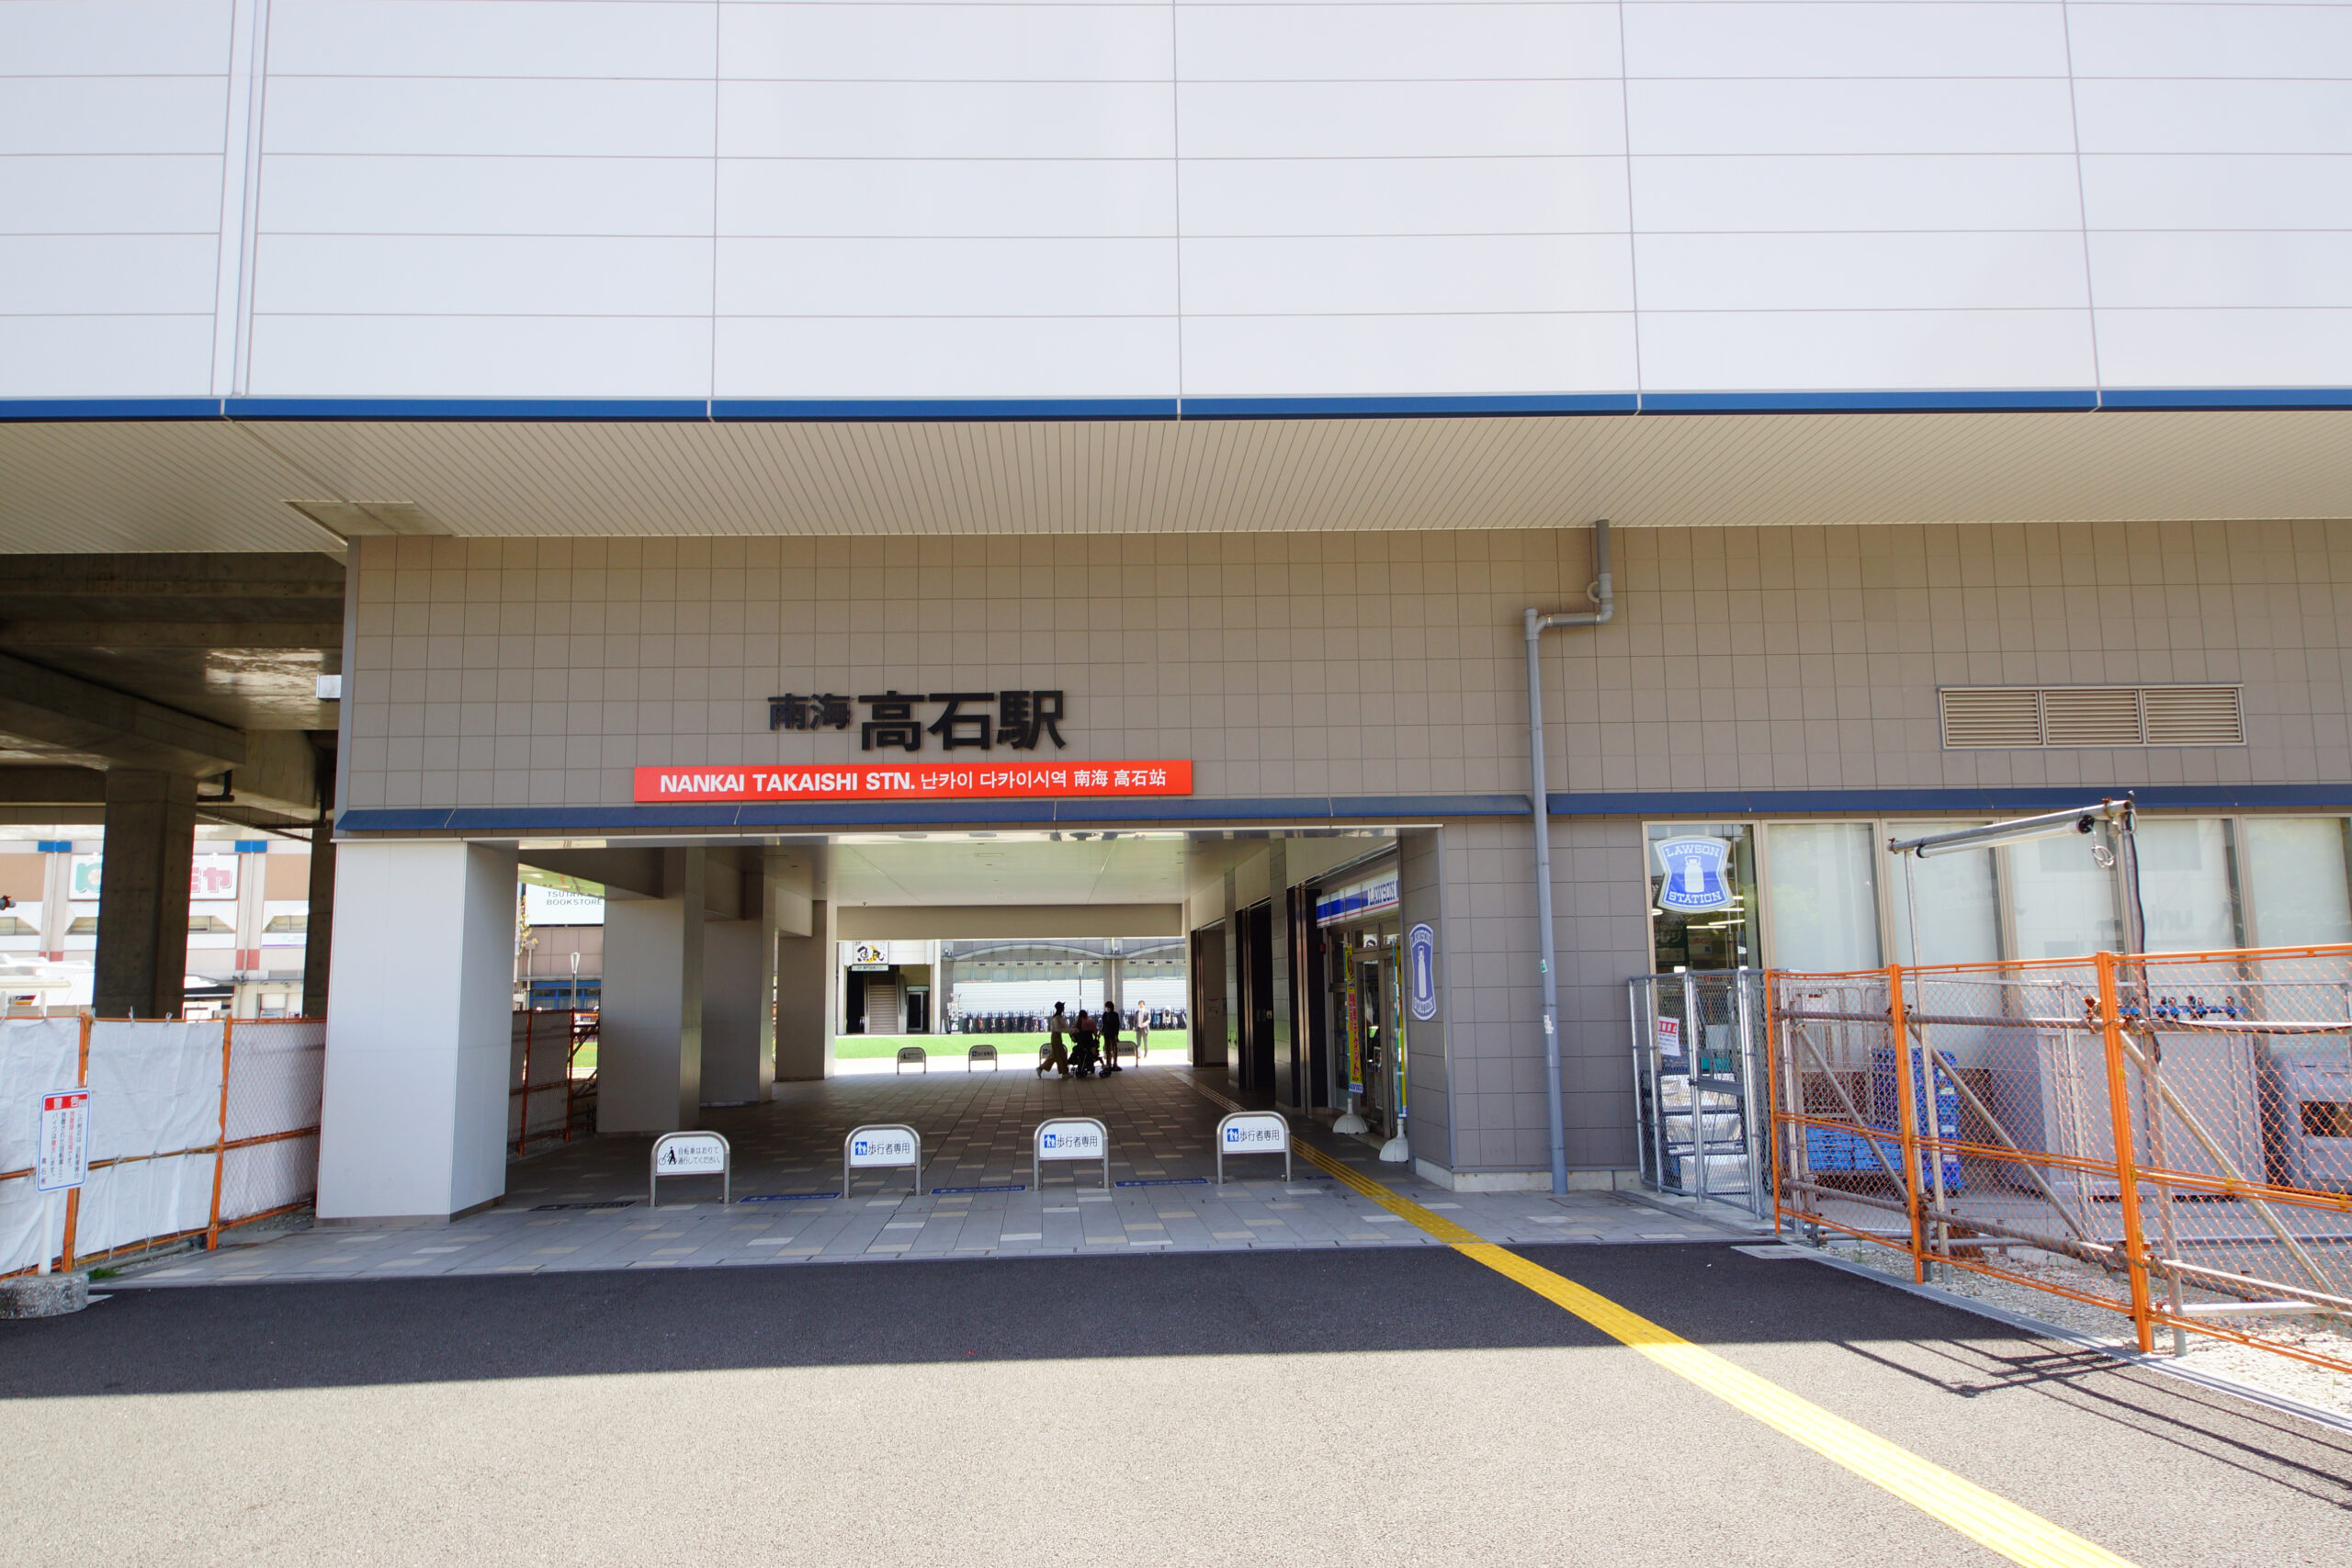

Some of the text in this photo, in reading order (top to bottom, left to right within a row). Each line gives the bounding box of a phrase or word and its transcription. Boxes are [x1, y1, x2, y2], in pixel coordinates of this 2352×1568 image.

[660, 773, 915, 793] NANKAI TAKAISHI STN.
[921, 770, 1067, 789] 난카이 다카이시역
[1074, 769, 1167, 787] 南海 高石站
[1665, 844, 1721, 857] LAWSON
[1369, 879, 1396, 906] LAWSON
[1668, 890, 1723, 904] STATION
[1410, 929, 1431, 948] LAWSON
[1057, 1135, 1098, 1148] 歩行者専用
[1239, 1129, 1280, 1142] 歩行者専用
[868, 1142, 910, 1155] 歩行者専用
